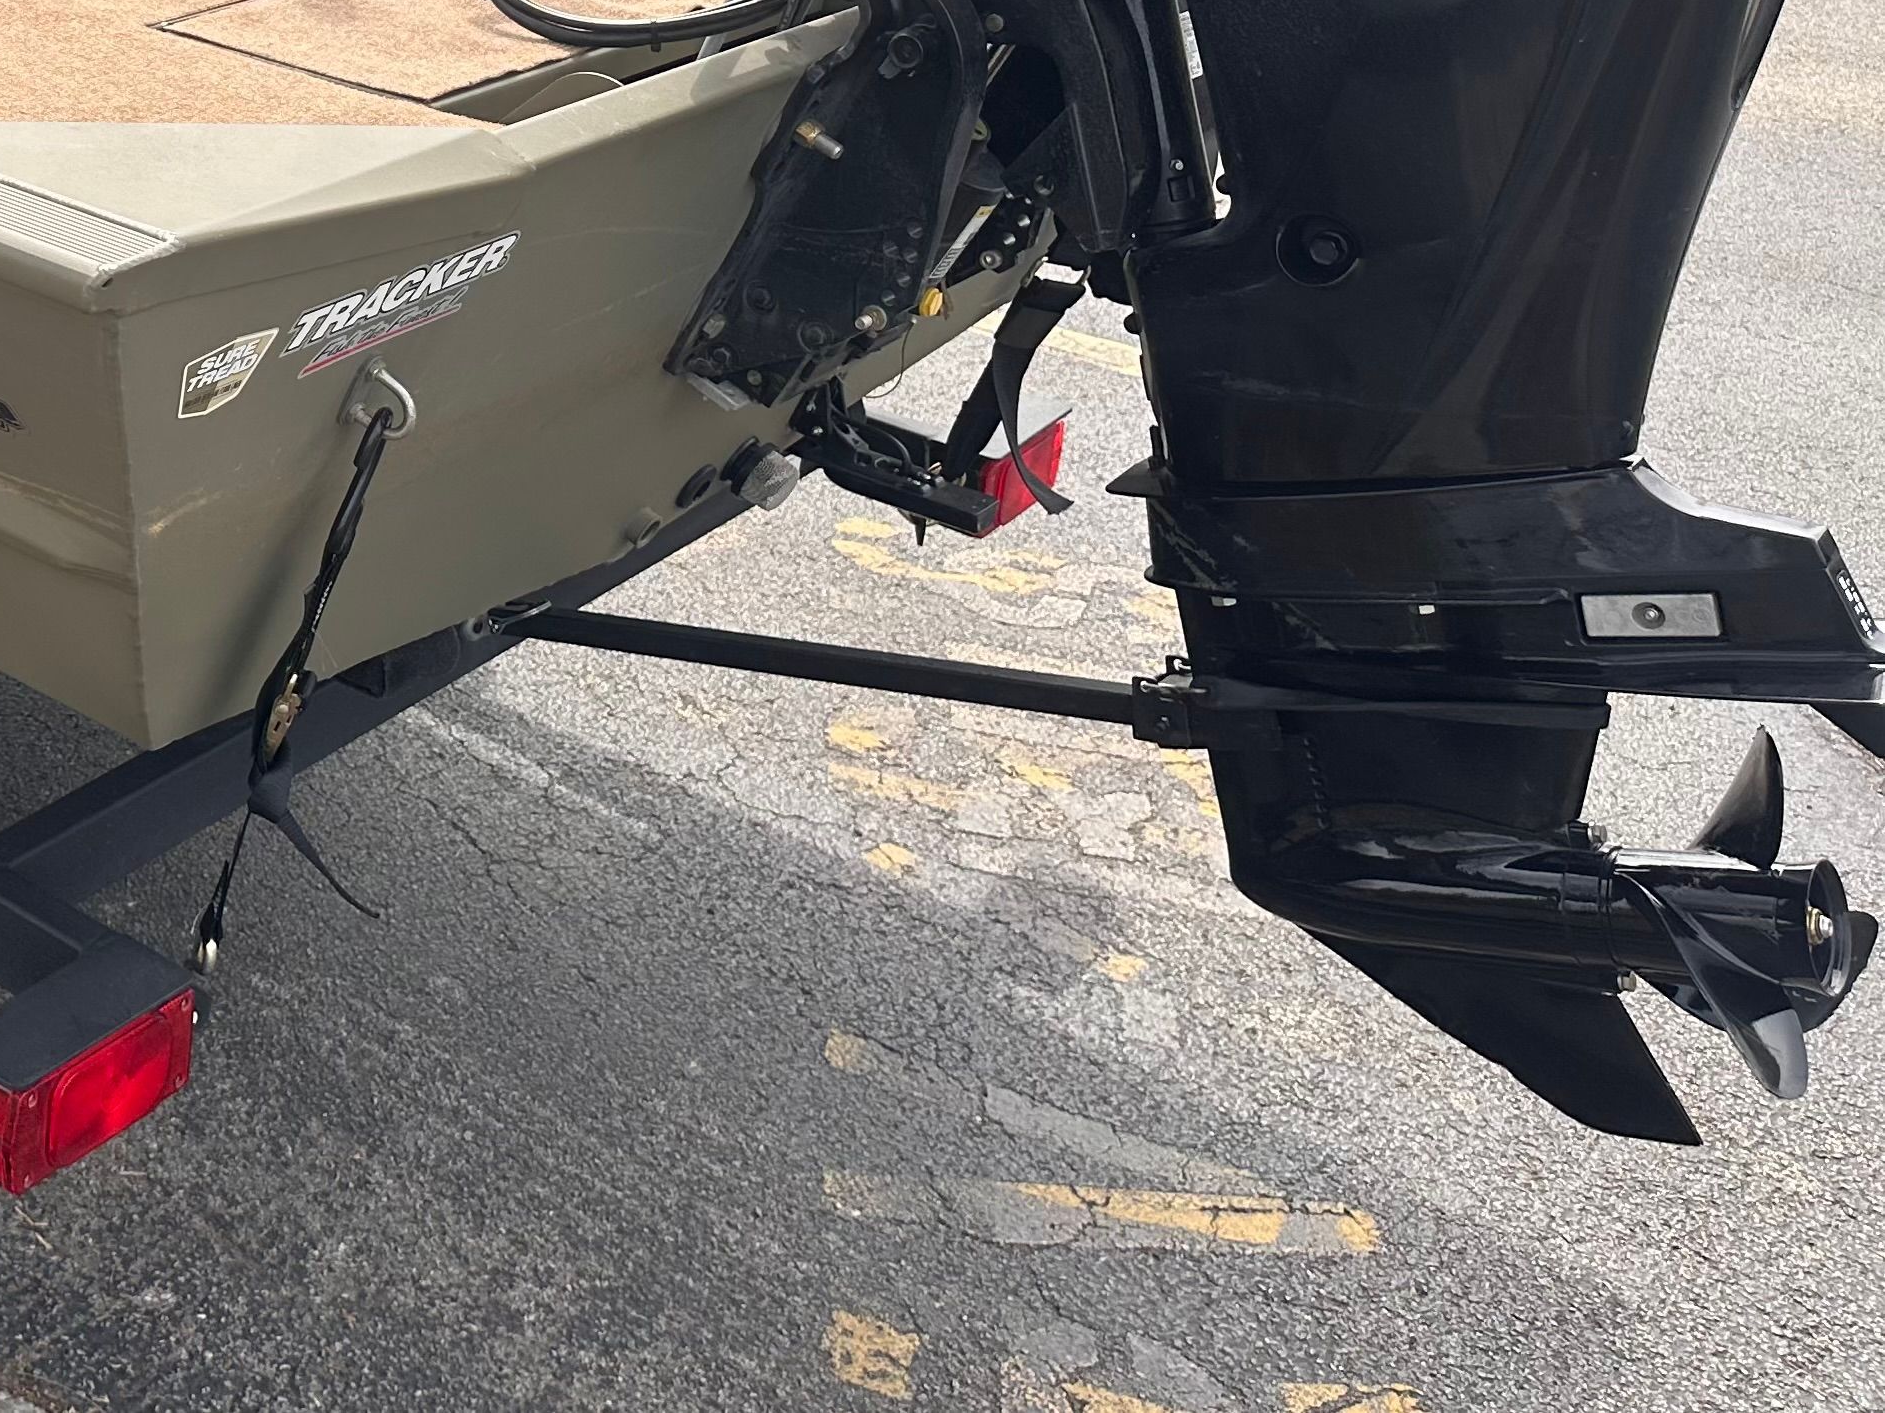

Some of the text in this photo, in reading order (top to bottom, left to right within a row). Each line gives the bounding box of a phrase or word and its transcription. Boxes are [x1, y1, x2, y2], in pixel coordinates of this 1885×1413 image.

[285, 233, 520, 353] TRACKER
[186, 353, 259, 393] TREAD
[197, 338, 261, 376] SURE
